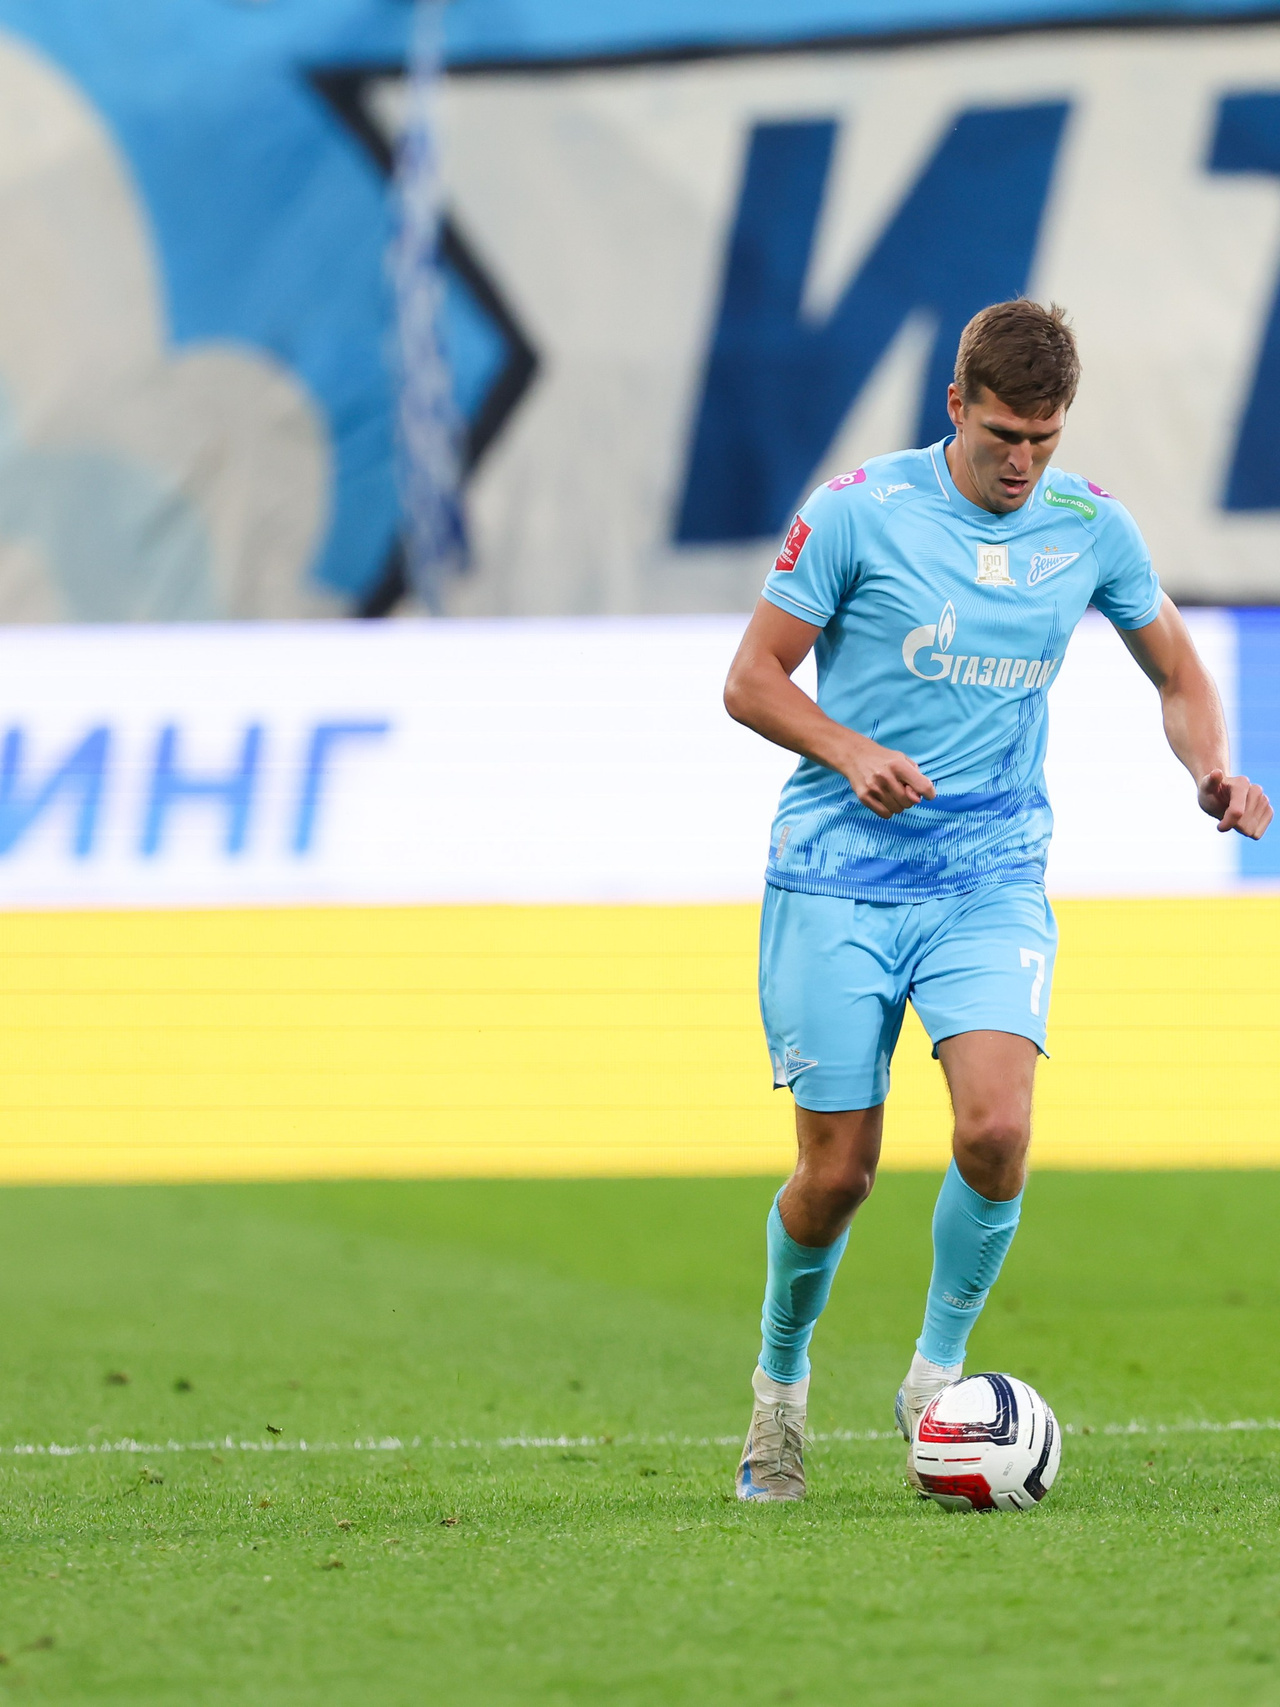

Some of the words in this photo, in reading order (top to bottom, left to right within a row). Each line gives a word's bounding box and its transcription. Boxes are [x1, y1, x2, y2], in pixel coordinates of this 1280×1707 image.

[670, 97, 1075, 548] И
[1052, 496, 1095, 516] МЕГАФОН
[1019, 947, 1046, 1017] 7
